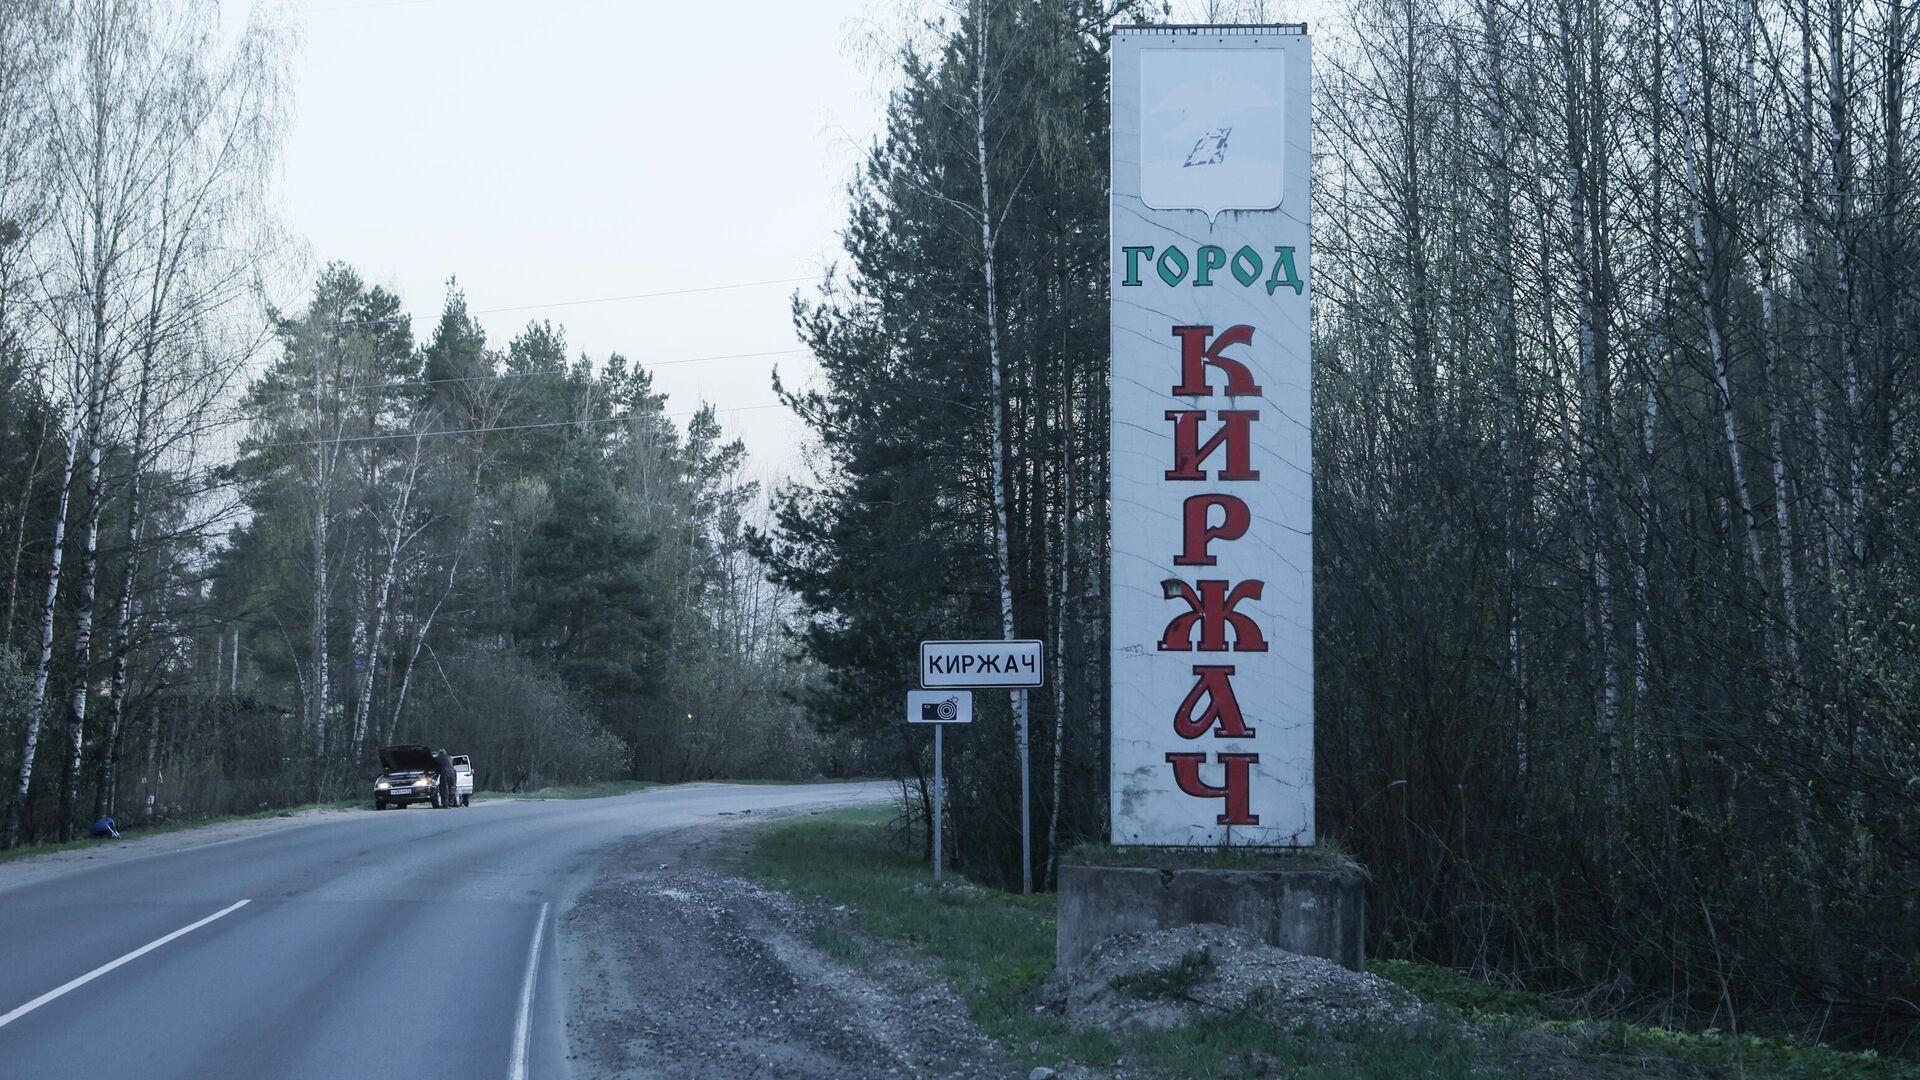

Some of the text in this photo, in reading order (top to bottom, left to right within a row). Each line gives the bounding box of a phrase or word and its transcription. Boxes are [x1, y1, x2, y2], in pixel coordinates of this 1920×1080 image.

[1121, 244, 1304, 296] ГОРОД
[1157, 324, 1269, 826] КИРЖАЧ
[929, 654, 1035, 674] КИРЖАЧ
